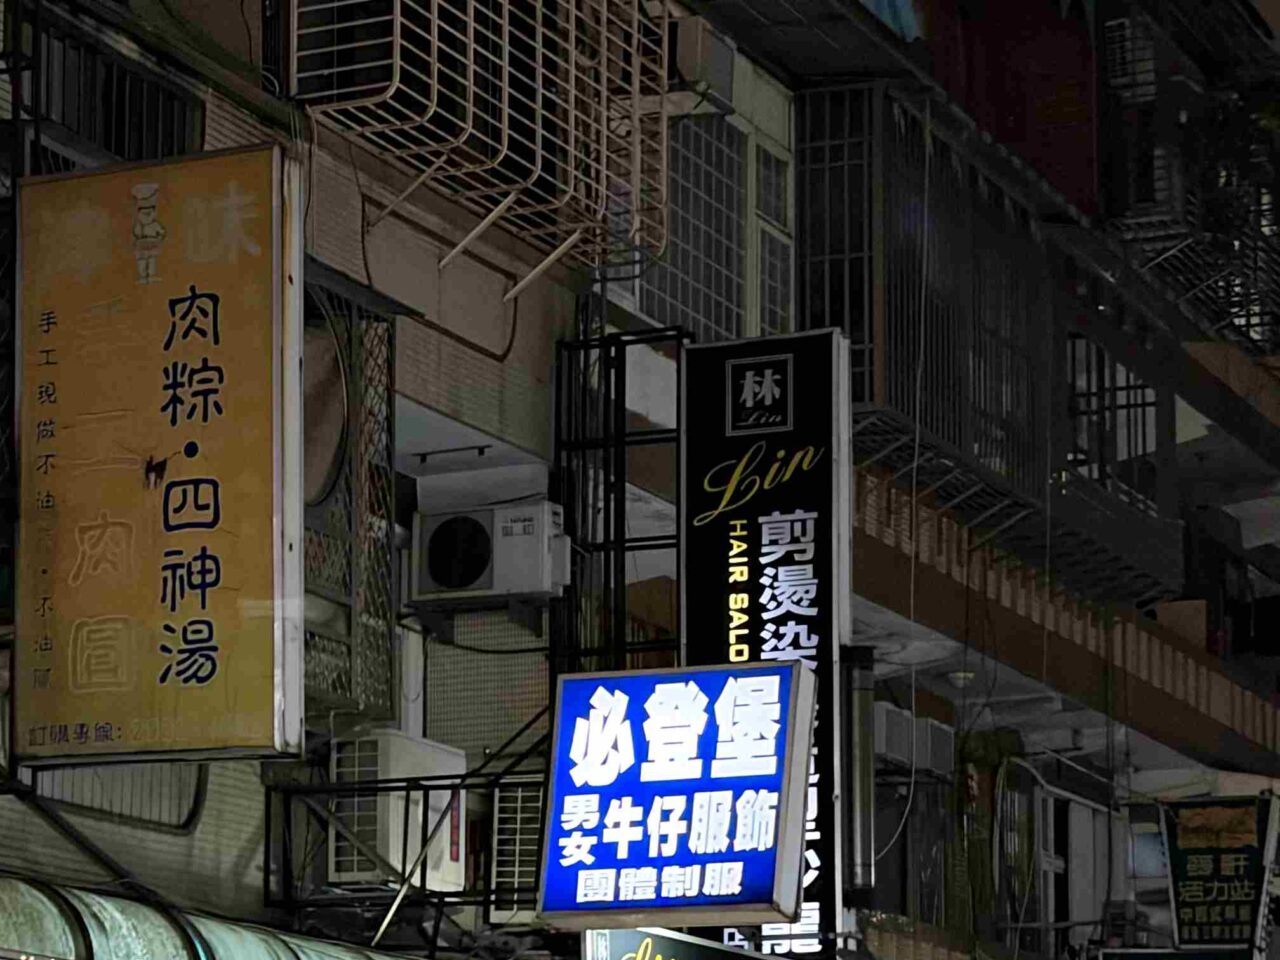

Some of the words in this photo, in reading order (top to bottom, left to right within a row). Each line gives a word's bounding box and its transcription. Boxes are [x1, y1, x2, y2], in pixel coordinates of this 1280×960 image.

[740, 369, 782, 408] 林
[693, 439, 826, 527] Lin
[728, 519, 750, 582] HAIR
[728, 592, 751, 663] SALO
[570, 674, 782, 787] 必登堡
[602, 789, 780, 859] 牛仔服飾
[575, 861, 745, 904] 團體制服
[1178, 879, 1254, 902] 活力站
